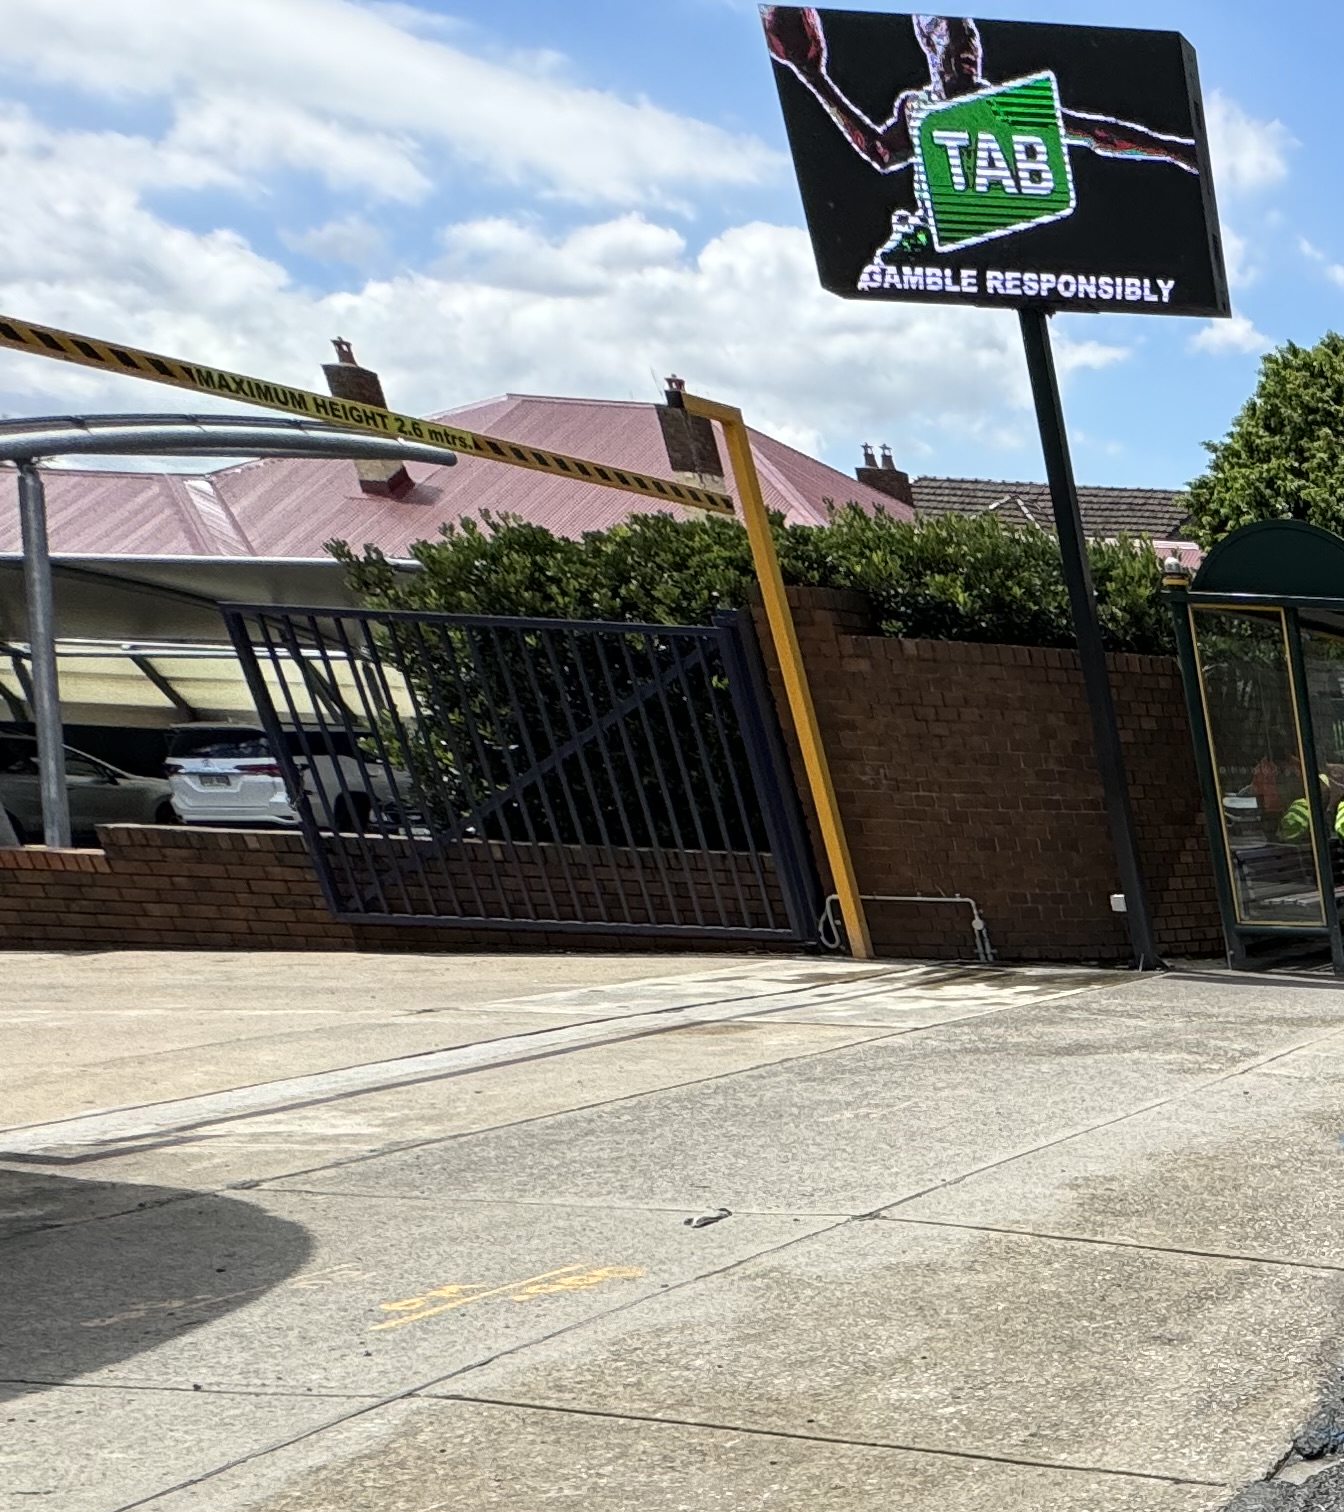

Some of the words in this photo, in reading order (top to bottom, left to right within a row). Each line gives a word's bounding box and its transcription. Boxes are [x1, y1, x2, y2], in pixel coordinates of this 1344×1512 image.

[932, 130, 1054, 195] TAB
[860, 264, 979, 294] GAMBLE
[986, 270, 1176, 303] RESPONSIBLY
[195, 366, 309, 412] MAXIMUM
[313, 397, 389, 431] HEIGHT
[394, 417, 424, 439] 2.6
[428, 428, 473, 451] mtrs.
